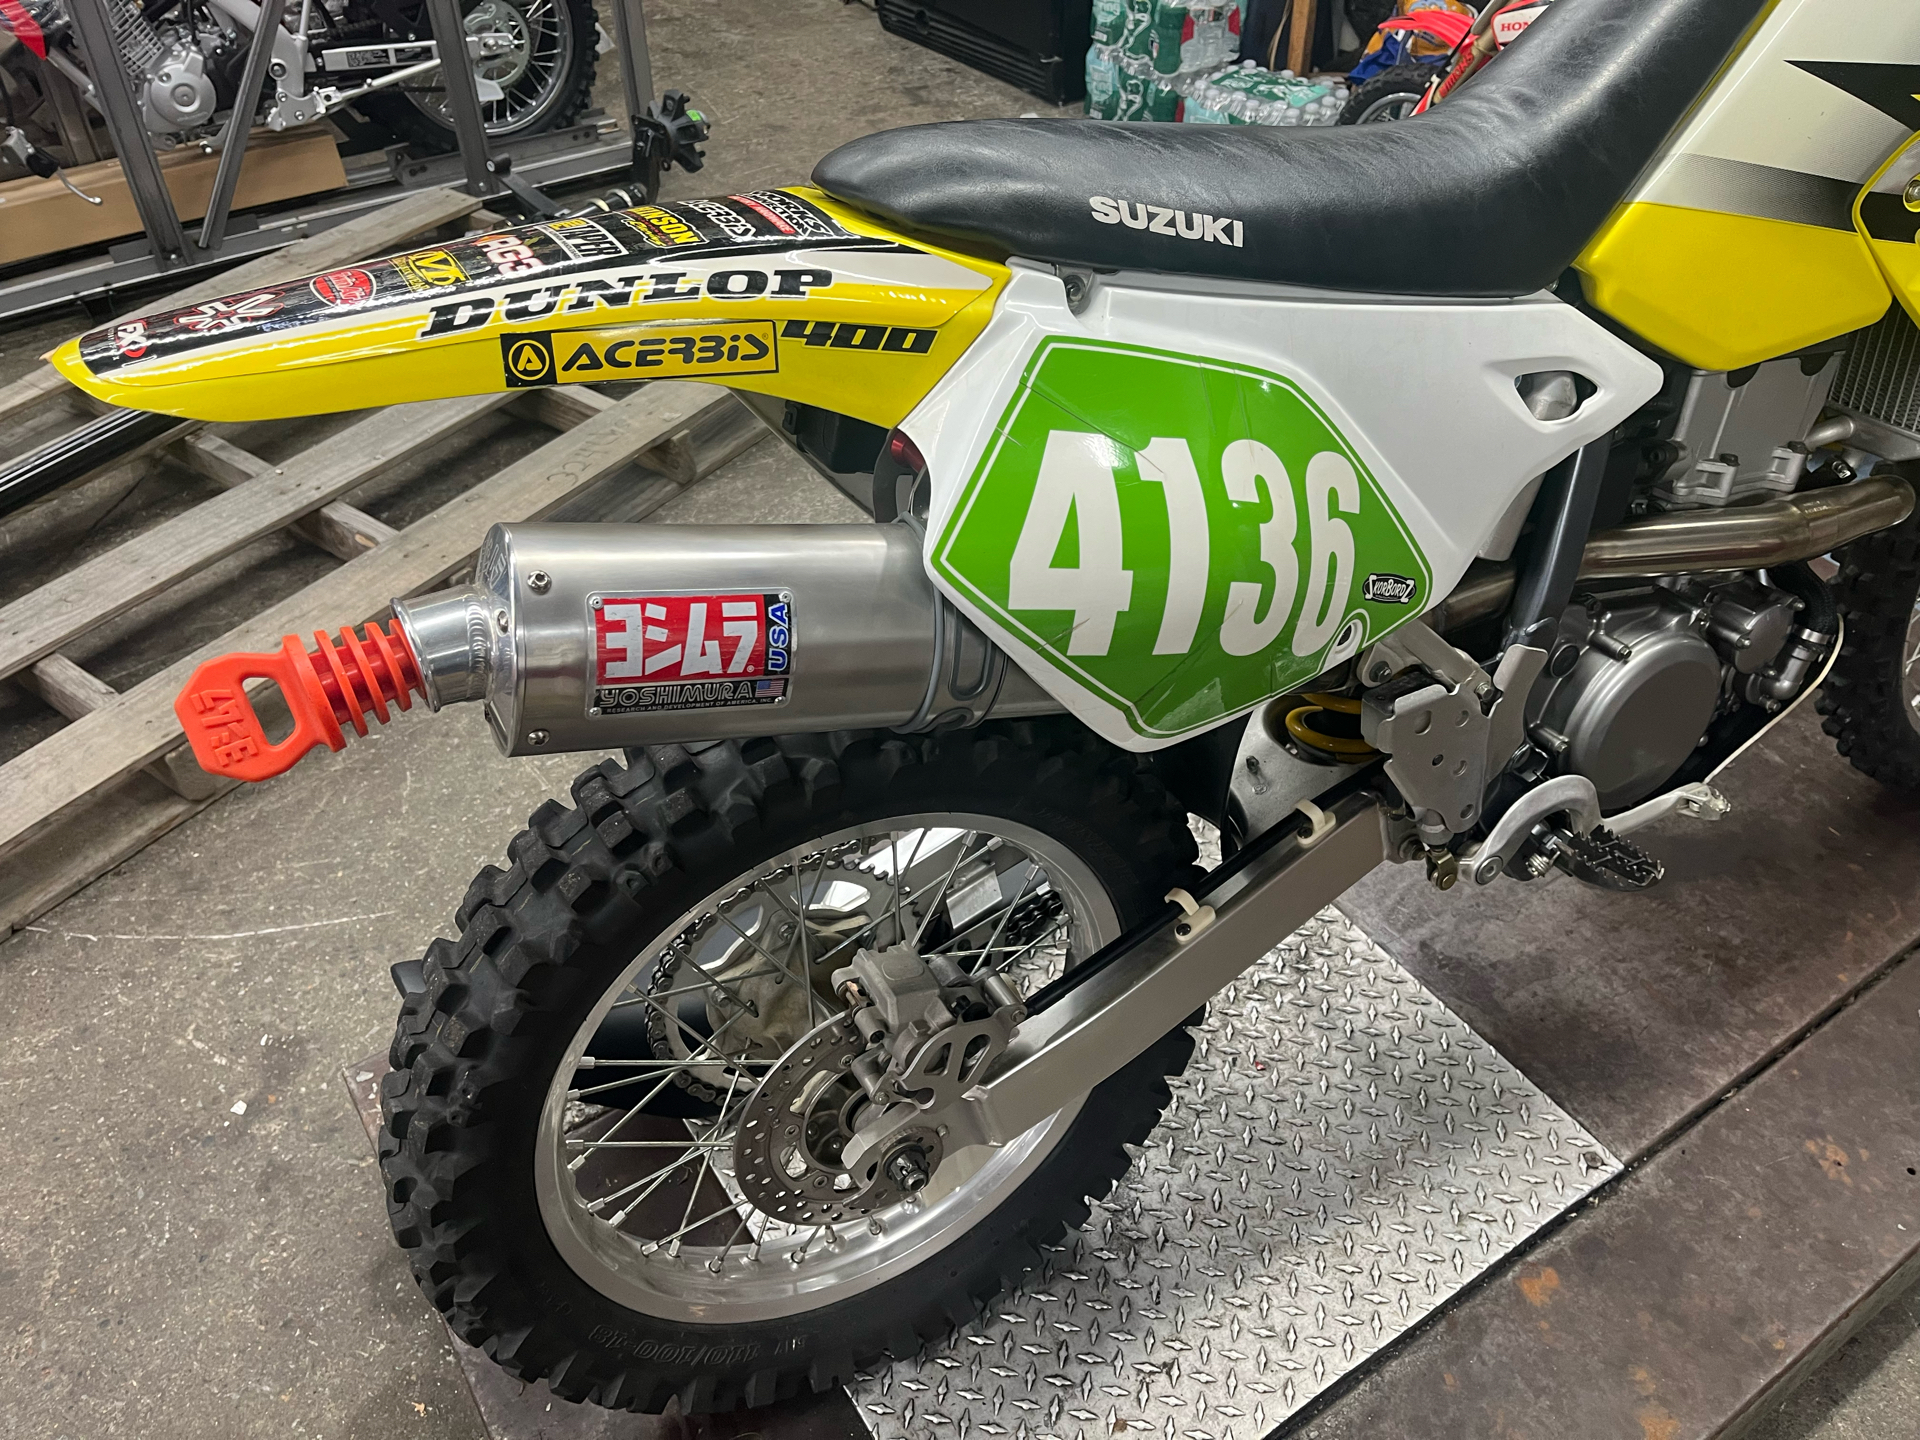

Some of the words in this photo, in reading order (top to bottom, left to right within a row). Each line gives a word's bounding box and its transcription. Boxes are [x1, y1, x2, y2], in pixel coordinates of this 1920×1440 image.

[1501, 22, 1531, 32] HON
[1089, 196, 1243, 247] SUZUKI
[481, 236, 545, 278] RG3
[419, 269, 832, 338] DUNLOP
[781, 320, 938, 354] 400
[1008, 430, 1360, 657] 4136
[603, 601, 758, 678] ヨシムラ
[768, 602, 789, 672] USA
[600, 680, 753, 707] YOSHIMURA
[606, 705, 645, 714] RESEARCH
[664, 701, 714, 710] DEVELOPMENT
